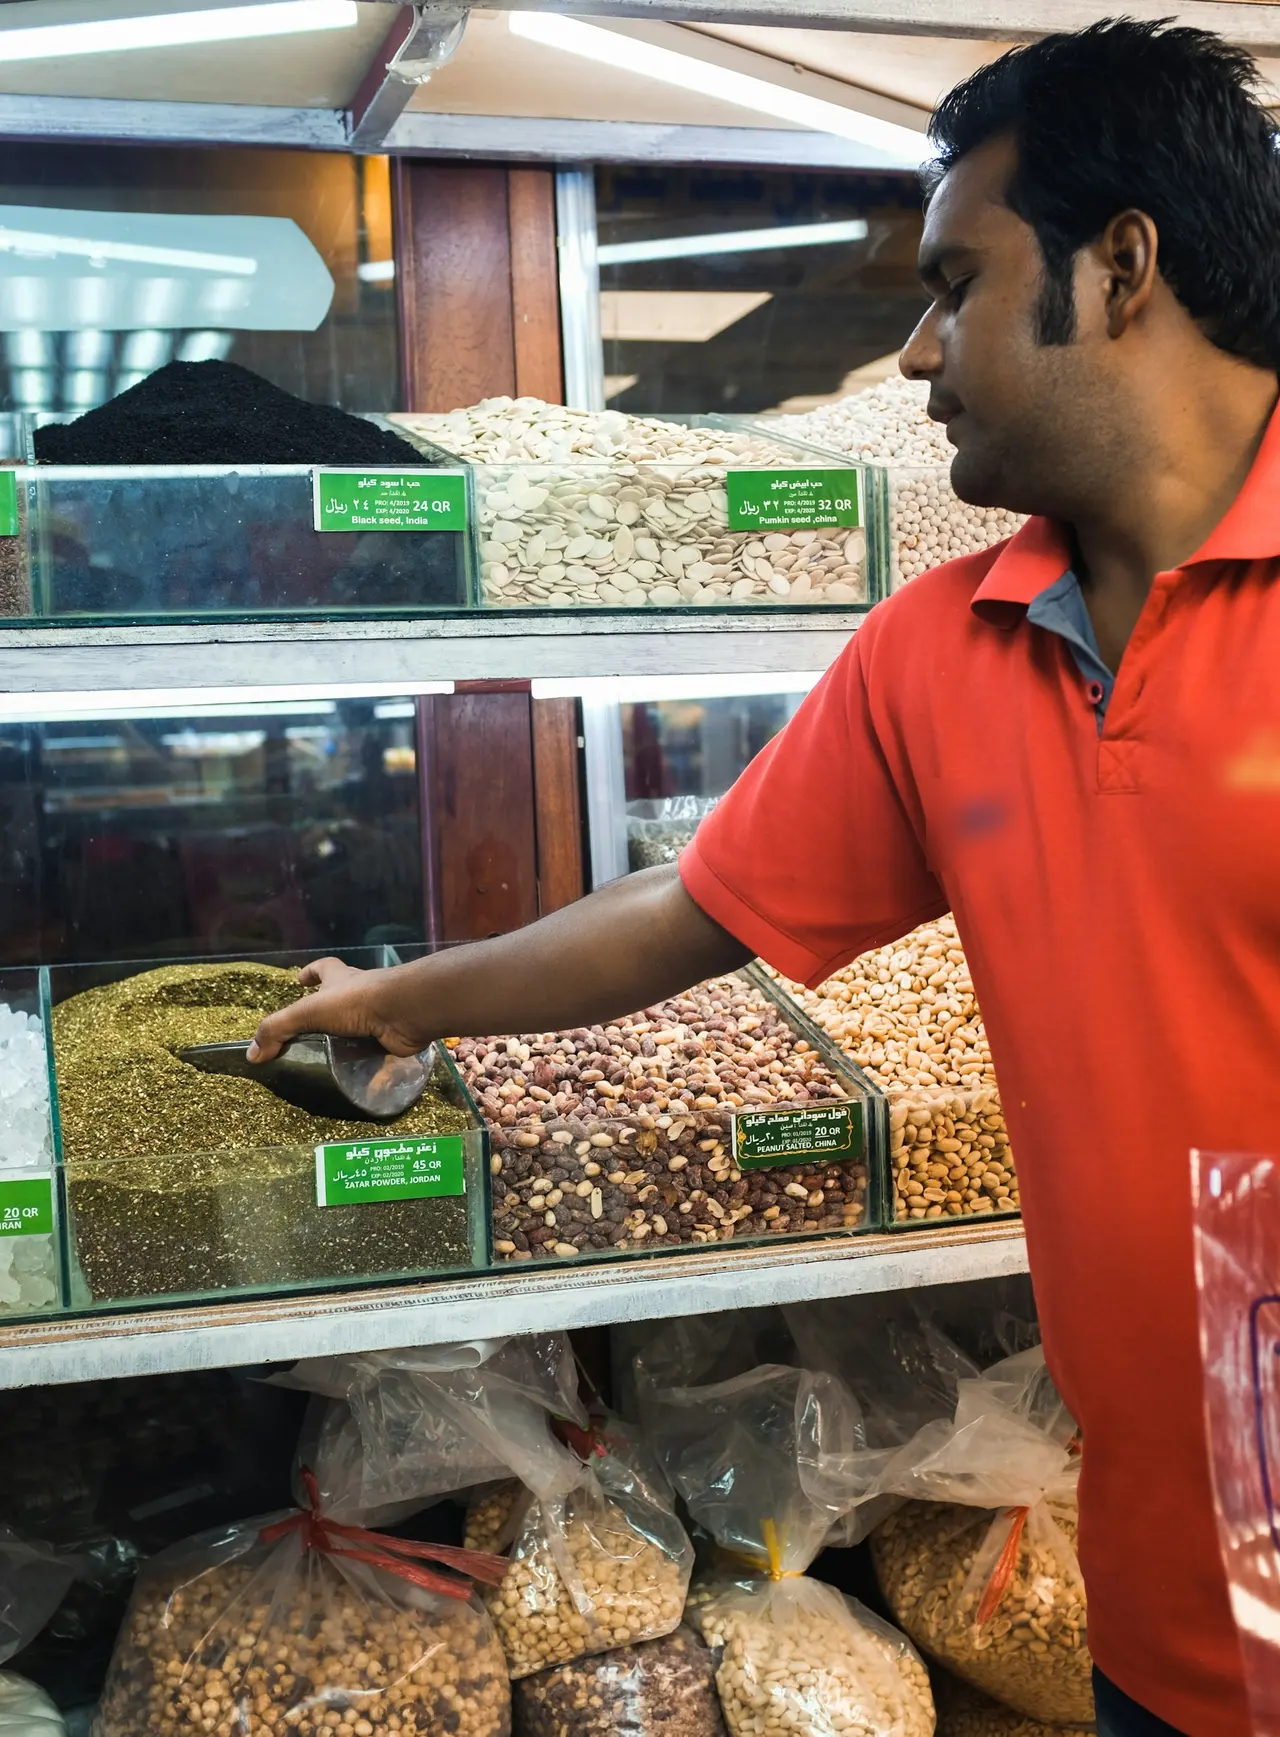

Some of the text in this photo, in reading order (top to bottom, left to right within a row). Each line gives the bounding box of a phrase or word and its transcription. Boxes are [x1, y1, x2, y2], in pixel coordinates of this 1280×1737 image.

[358, 478, 377, 488] كيلو
[326, 498, 348, 514] ريال
[413, 500, 451, 513] 24 QR
[739, 500, 759, 515] ريال
[818, 499, 852, 511] 32 QR
[351, 515, 428, 526] Black seed, India
[759, 516, 789, 524] Pumkin
[791, 515, 811, 523] seed
[828, 1108, 847, 1120] فول
[746, 1115, 766, 1127] كيلو
[815, 1127, 828, 1137] 20
[416, 1142, 437, 1155] زعتر
[757, 1139, 837, 1153] PEANUT SALTED, CHINA
[346, 1147, 370, 1160] كيلو
[413, 1160, 441, 1171] 45 QR
[345, 1175, 441, 1189] ZATAR POWDER, JORDAN
[4, 1207, 39, 1220] 20 QR
